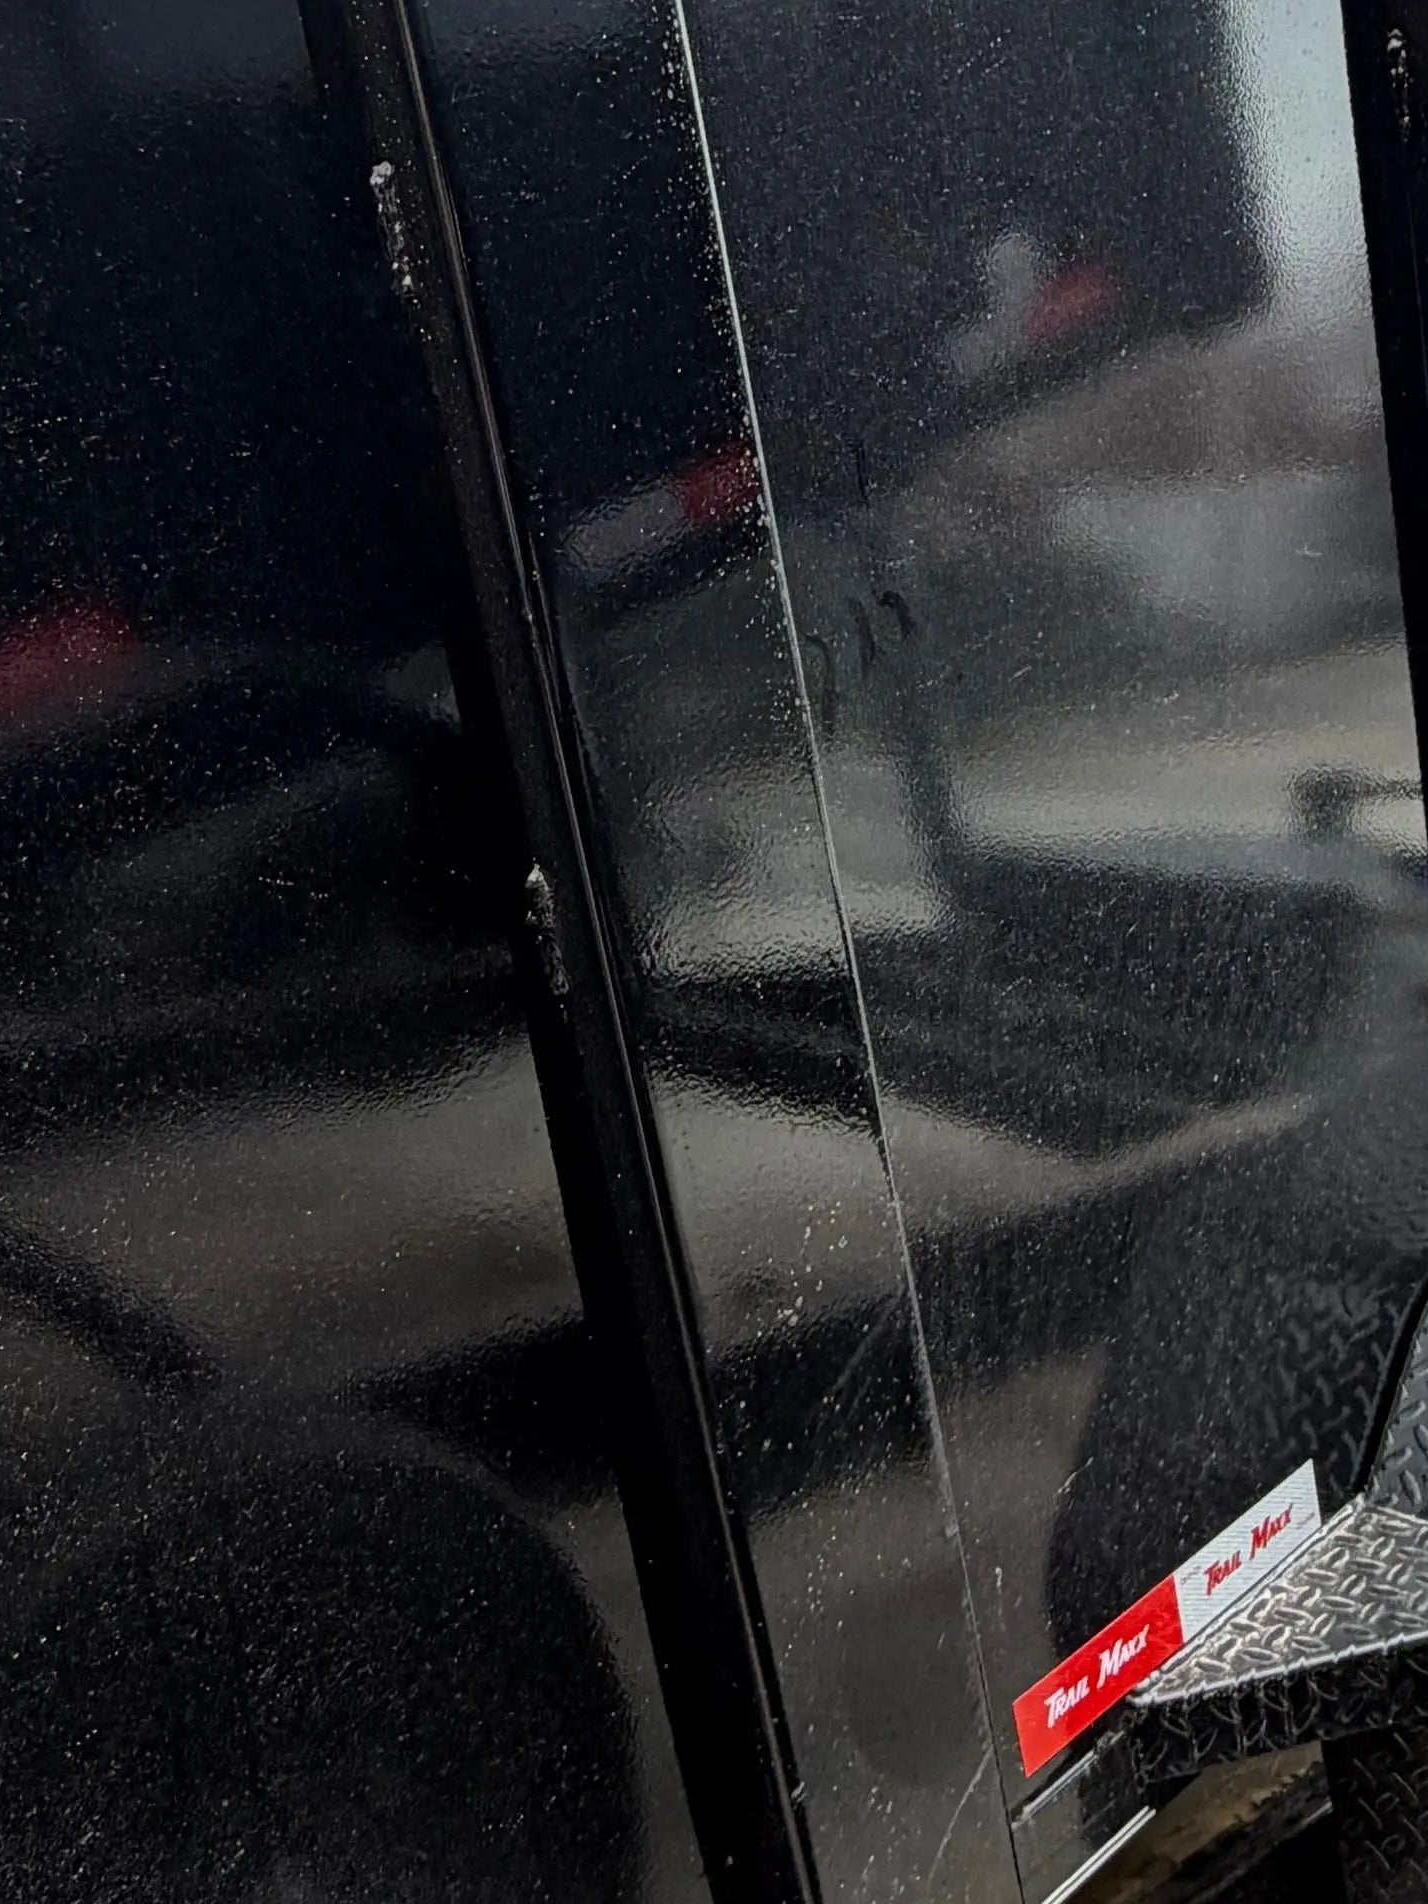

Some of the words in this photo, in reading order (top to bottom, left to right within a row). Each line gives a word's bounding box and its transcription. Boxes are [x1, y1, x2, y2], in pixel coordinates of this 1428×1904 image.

[1203, 1550, 1242, 1597] TRAIL
[1249, 1502, 1294, 1560] MAXX
[1043, 1675, 1090, 1728] TRAIL
[1096, 1623, 1150, 1689] MAXX
